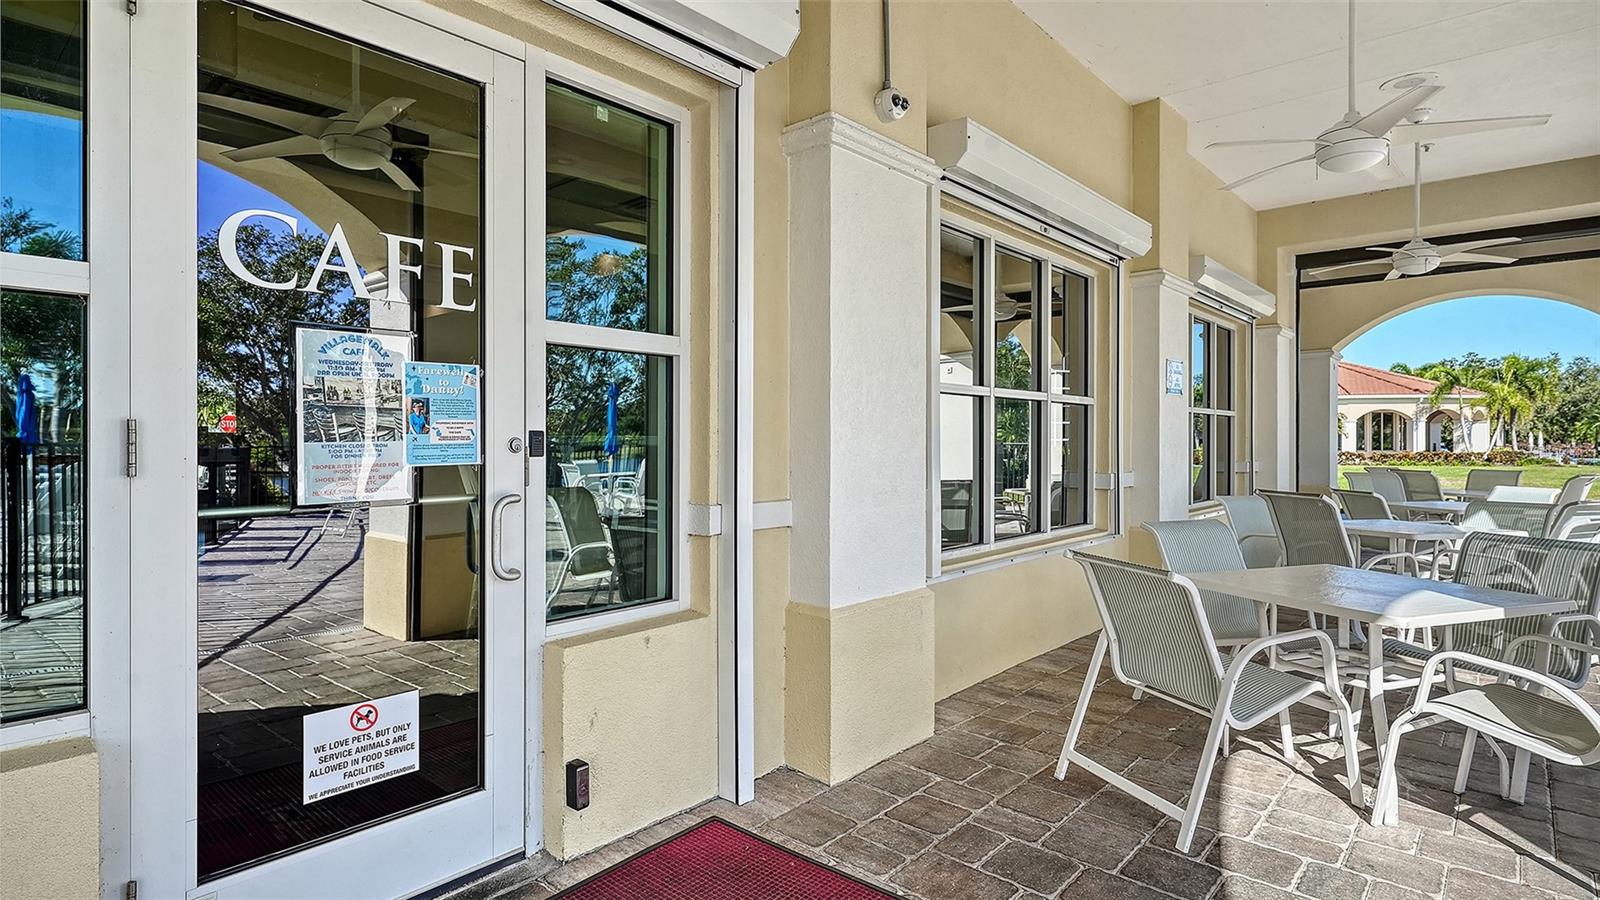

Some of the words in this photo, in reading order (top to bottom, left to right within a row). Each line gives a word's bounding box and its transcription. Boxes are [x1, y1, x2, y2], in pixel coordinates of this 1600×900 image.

[218, 209, 476, 312] CAFE
[418, 367, 464, 376] Farewell
[422, 384, 464, 397] Danny!
[314, 744, 327, 754] WE
[329, 738, 349, 750] LOVE
[352, 733, 374, 744] PETS,
[376, 728, 390, 738] BUT
[392, 722, 411, 733] ONLY
[318, 749, 353, 764] SERVICE
[355, 738, 390, 754] ANIMALS
[392, 734, 407, 744] ARE
[309, 761, 348, 778] ALLOWED
[351, 758, 359, 766] IN
[362, 752, 382, 764] FOOD
[384, 742, 415, 757] SERVICE
[343, 762, 385, 780] FACILITIES
[319, 782, 354, 798] APPRECIATE
[356, 777, 370, 786] YOUR
[372, 764, 415, 781] UNDERSTANDING
